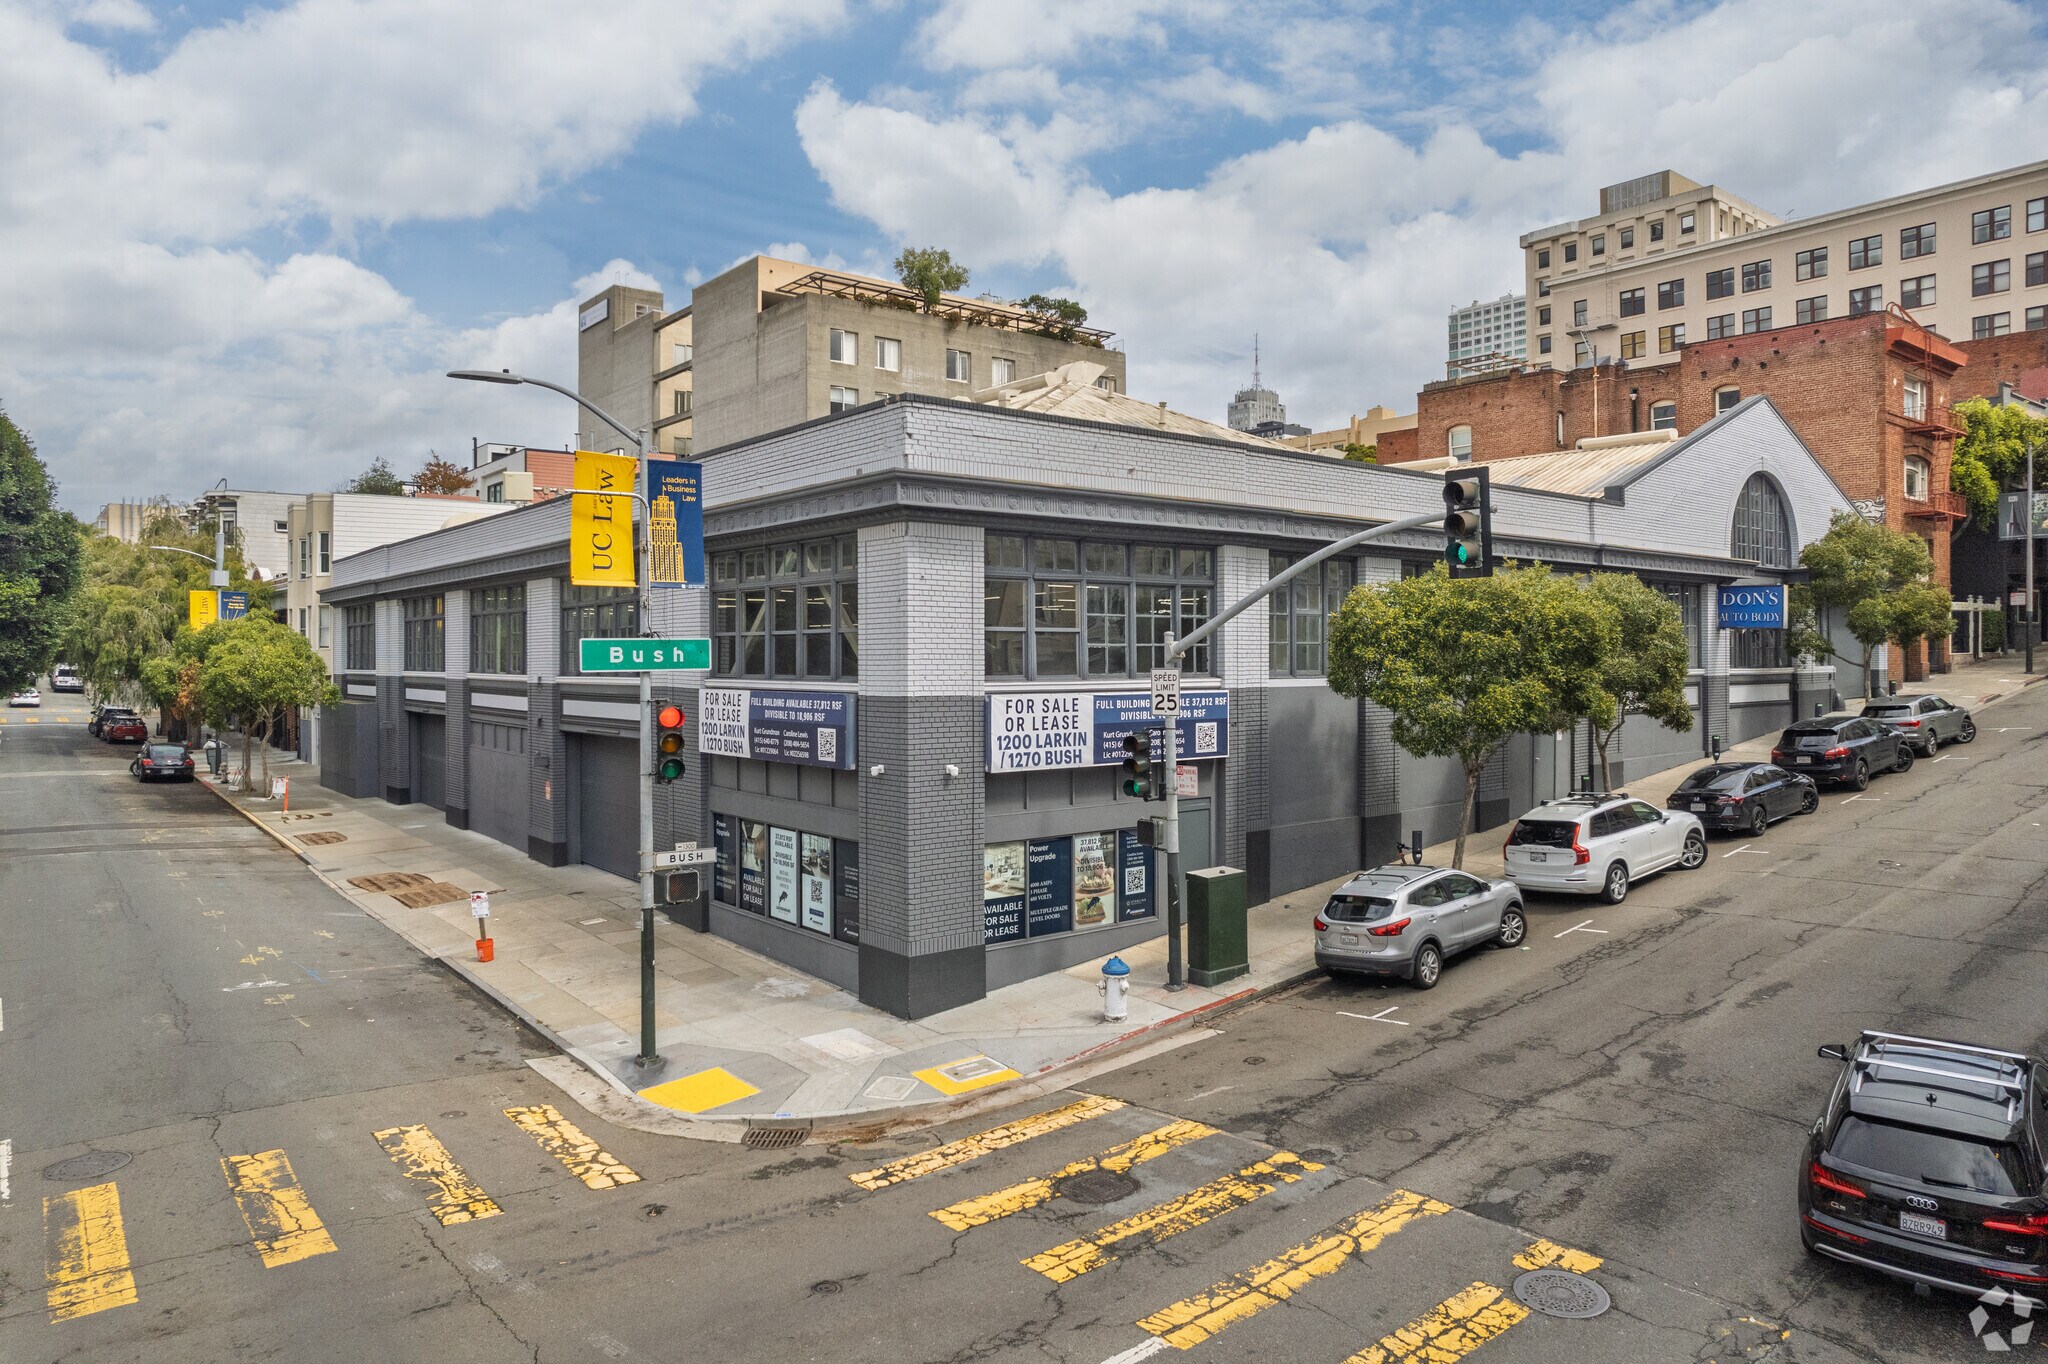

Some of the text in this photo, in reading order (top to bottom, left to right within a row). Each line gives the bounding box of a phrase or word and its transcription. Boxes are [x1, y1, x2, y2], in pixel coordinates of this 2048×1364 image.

[662, 476, 688, 484] Leaders
[592, 469, 614, 571] UC Law
[1722, 590, 1778, 606] DON'S
[1720, 612, 1780, 622] AUTO BODY
[610, 646, 684, 663] Bush
[705, 692, 742, 707] FOR SALE
[751, 697, 761, 706] FULL
[763, 698, 784, 707] BUILDING
[786, 699, 812, 708] AVAILABLE
[832, 701, 843, 710] RSF
[1096, 699, 1150, 709] FULL BUILDING
[1154, 694, 1177, 711] 25
[1192, 698, 1213, 707] 37,812
[1215, 697, 1227, 705] RSF
[1006, 698, 1079, 714] FOR SALE
[705, 707, 741, 722] OR LEASE
[765, 710, 788, 719] DIVISIBLE
[789, 711, 795, 720] TO
[814, 713, 825, 722] RSF
[1194, 709, 1206, 717] RSF
[1005, 715, 1078, 732] OR LEASE
[702, 722, 745, 738] 1200 LARKIN
[707, 738, 722, 751] 1270
[724, 739, 743, 754] BUSH
[997, 732, 1086, 750] 1200 LARKIN
[1009, 752, 1041, 768] 1270
[1045, 749, 1082, 766] BUSH
[1080, 843, 1109, 853] AVAILABLE
[670, 852, 703, 862] BUSH
[1030, 853, 1056, 862] Upgrade
[1081, 856, 1107, 865] DIVISIBLE
[744, 874, 764, 885] AVAILABLE
[743, 883, 762, 895] FOR SALE
[750, 895, 762, 906] LEASE
[1030, 907, 1052, 915] MULTIPLE
[999, 913, 1018, 924] SALE
[995, 925, 1019, 937] LEASE
[1902, 1218, 1943, 1236] 8ZRR949
